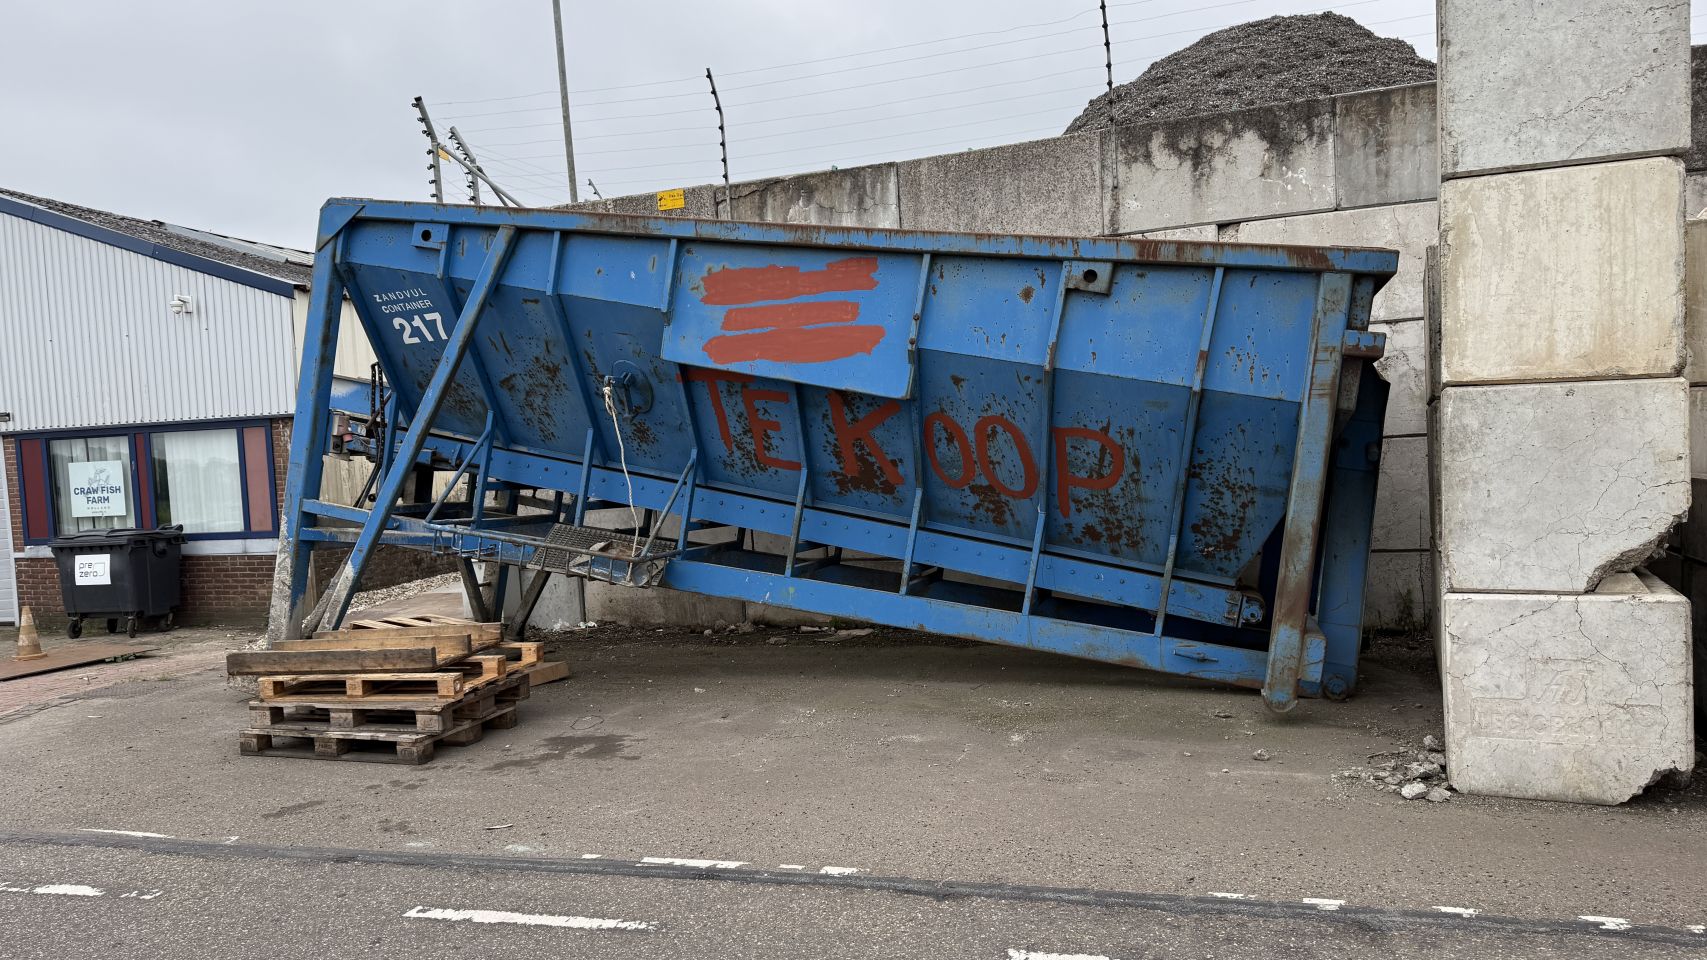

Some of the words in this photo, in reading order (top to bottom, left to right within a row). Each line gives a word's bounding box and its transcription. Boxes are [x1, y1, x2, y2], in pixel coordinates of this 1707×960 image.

[374, 288, 427, 302] ZANDVUL
[382, 300, 432, 313] CONTAINER
[393, 312, 448, 344] 217
[676, 369, 802, 471] TE
[828, 390, 1125, 518] KOOP
[74, 487, 99, 495] CRAW
[102, 486, 121, 494] FISH
[87, 496, 110, 504] FARM
[79, 562, 93, 571] pre
[79, 570, 98, 578] zero
